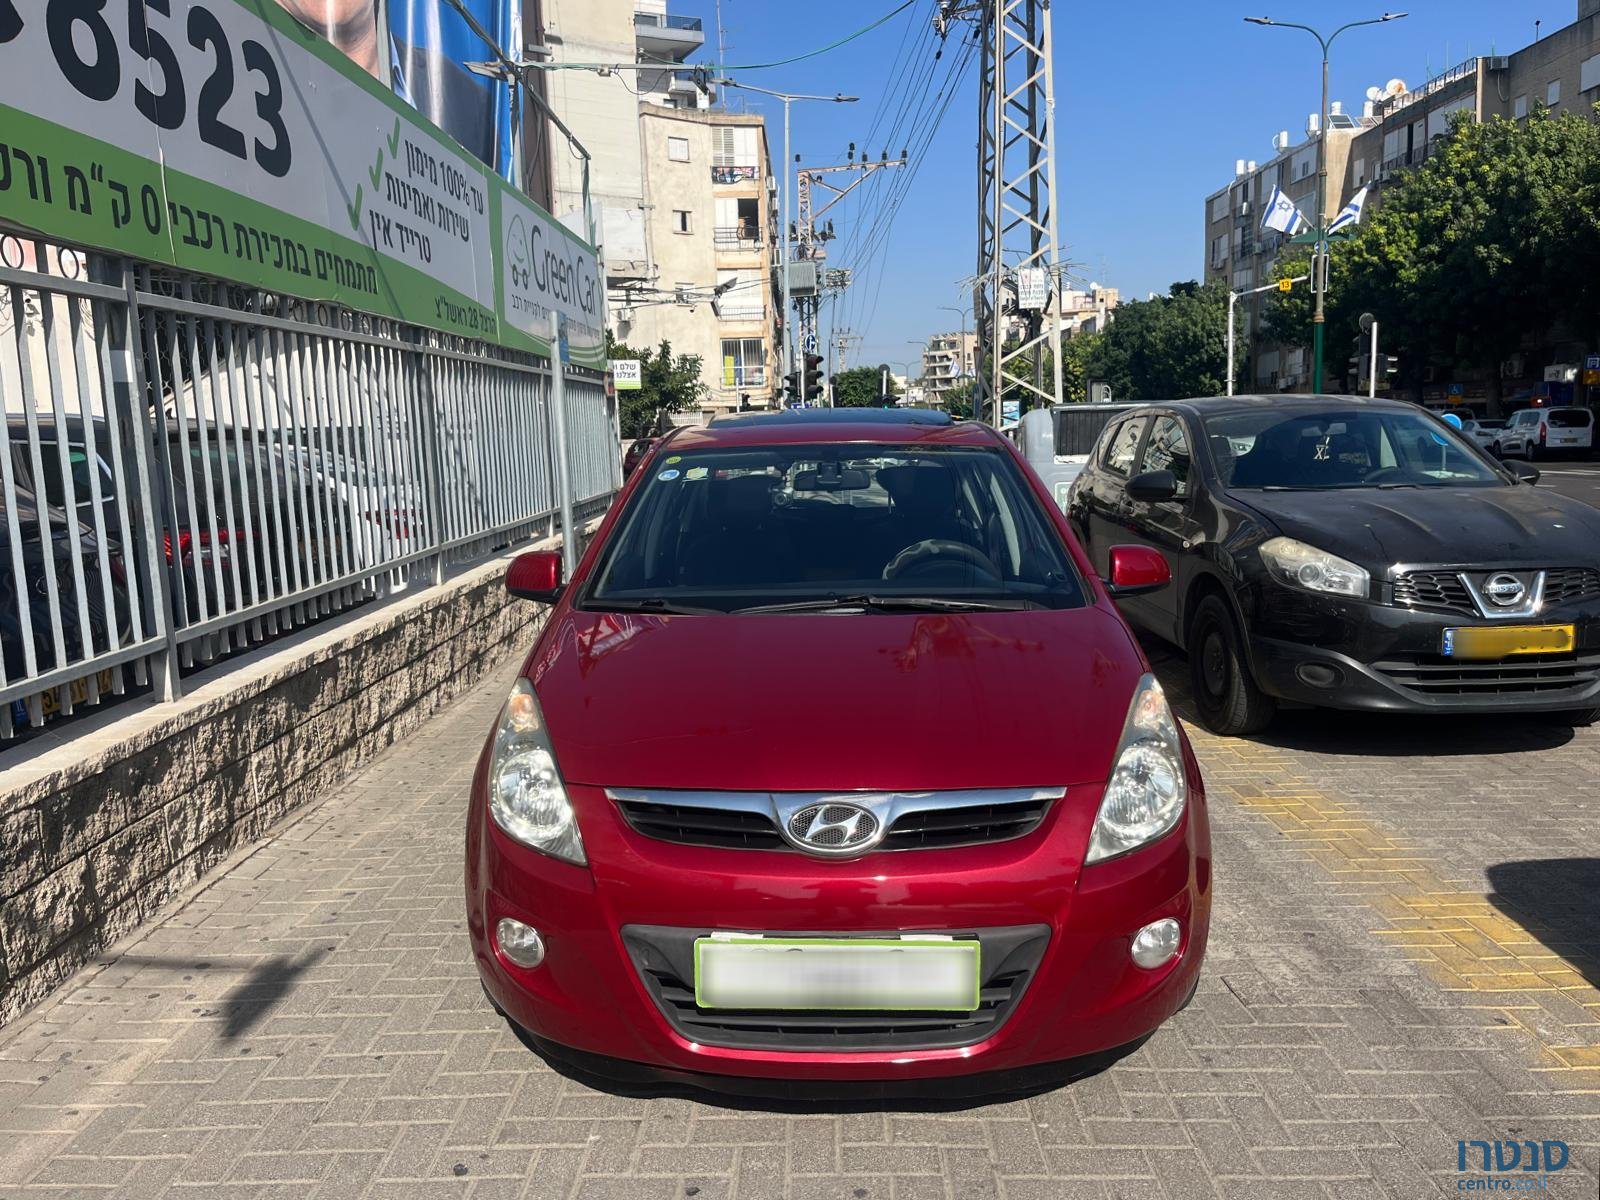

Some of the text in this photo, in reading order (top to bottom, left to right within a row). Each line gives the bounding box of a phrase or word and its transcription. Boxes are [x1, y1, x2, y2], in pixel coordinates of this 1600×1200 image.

[0, 0, 292, 178] 8523
[405, 139, 484, 215] עד 100% מימון
[167, 201, 229, 254] רכבי
[385, 171, 469, 242] שירות ואמינות
[233, 222, 311, 276] במכירת
[369, 209, 431, 263] טרייד אין
[313, 248, 378, 295] מתמחים
